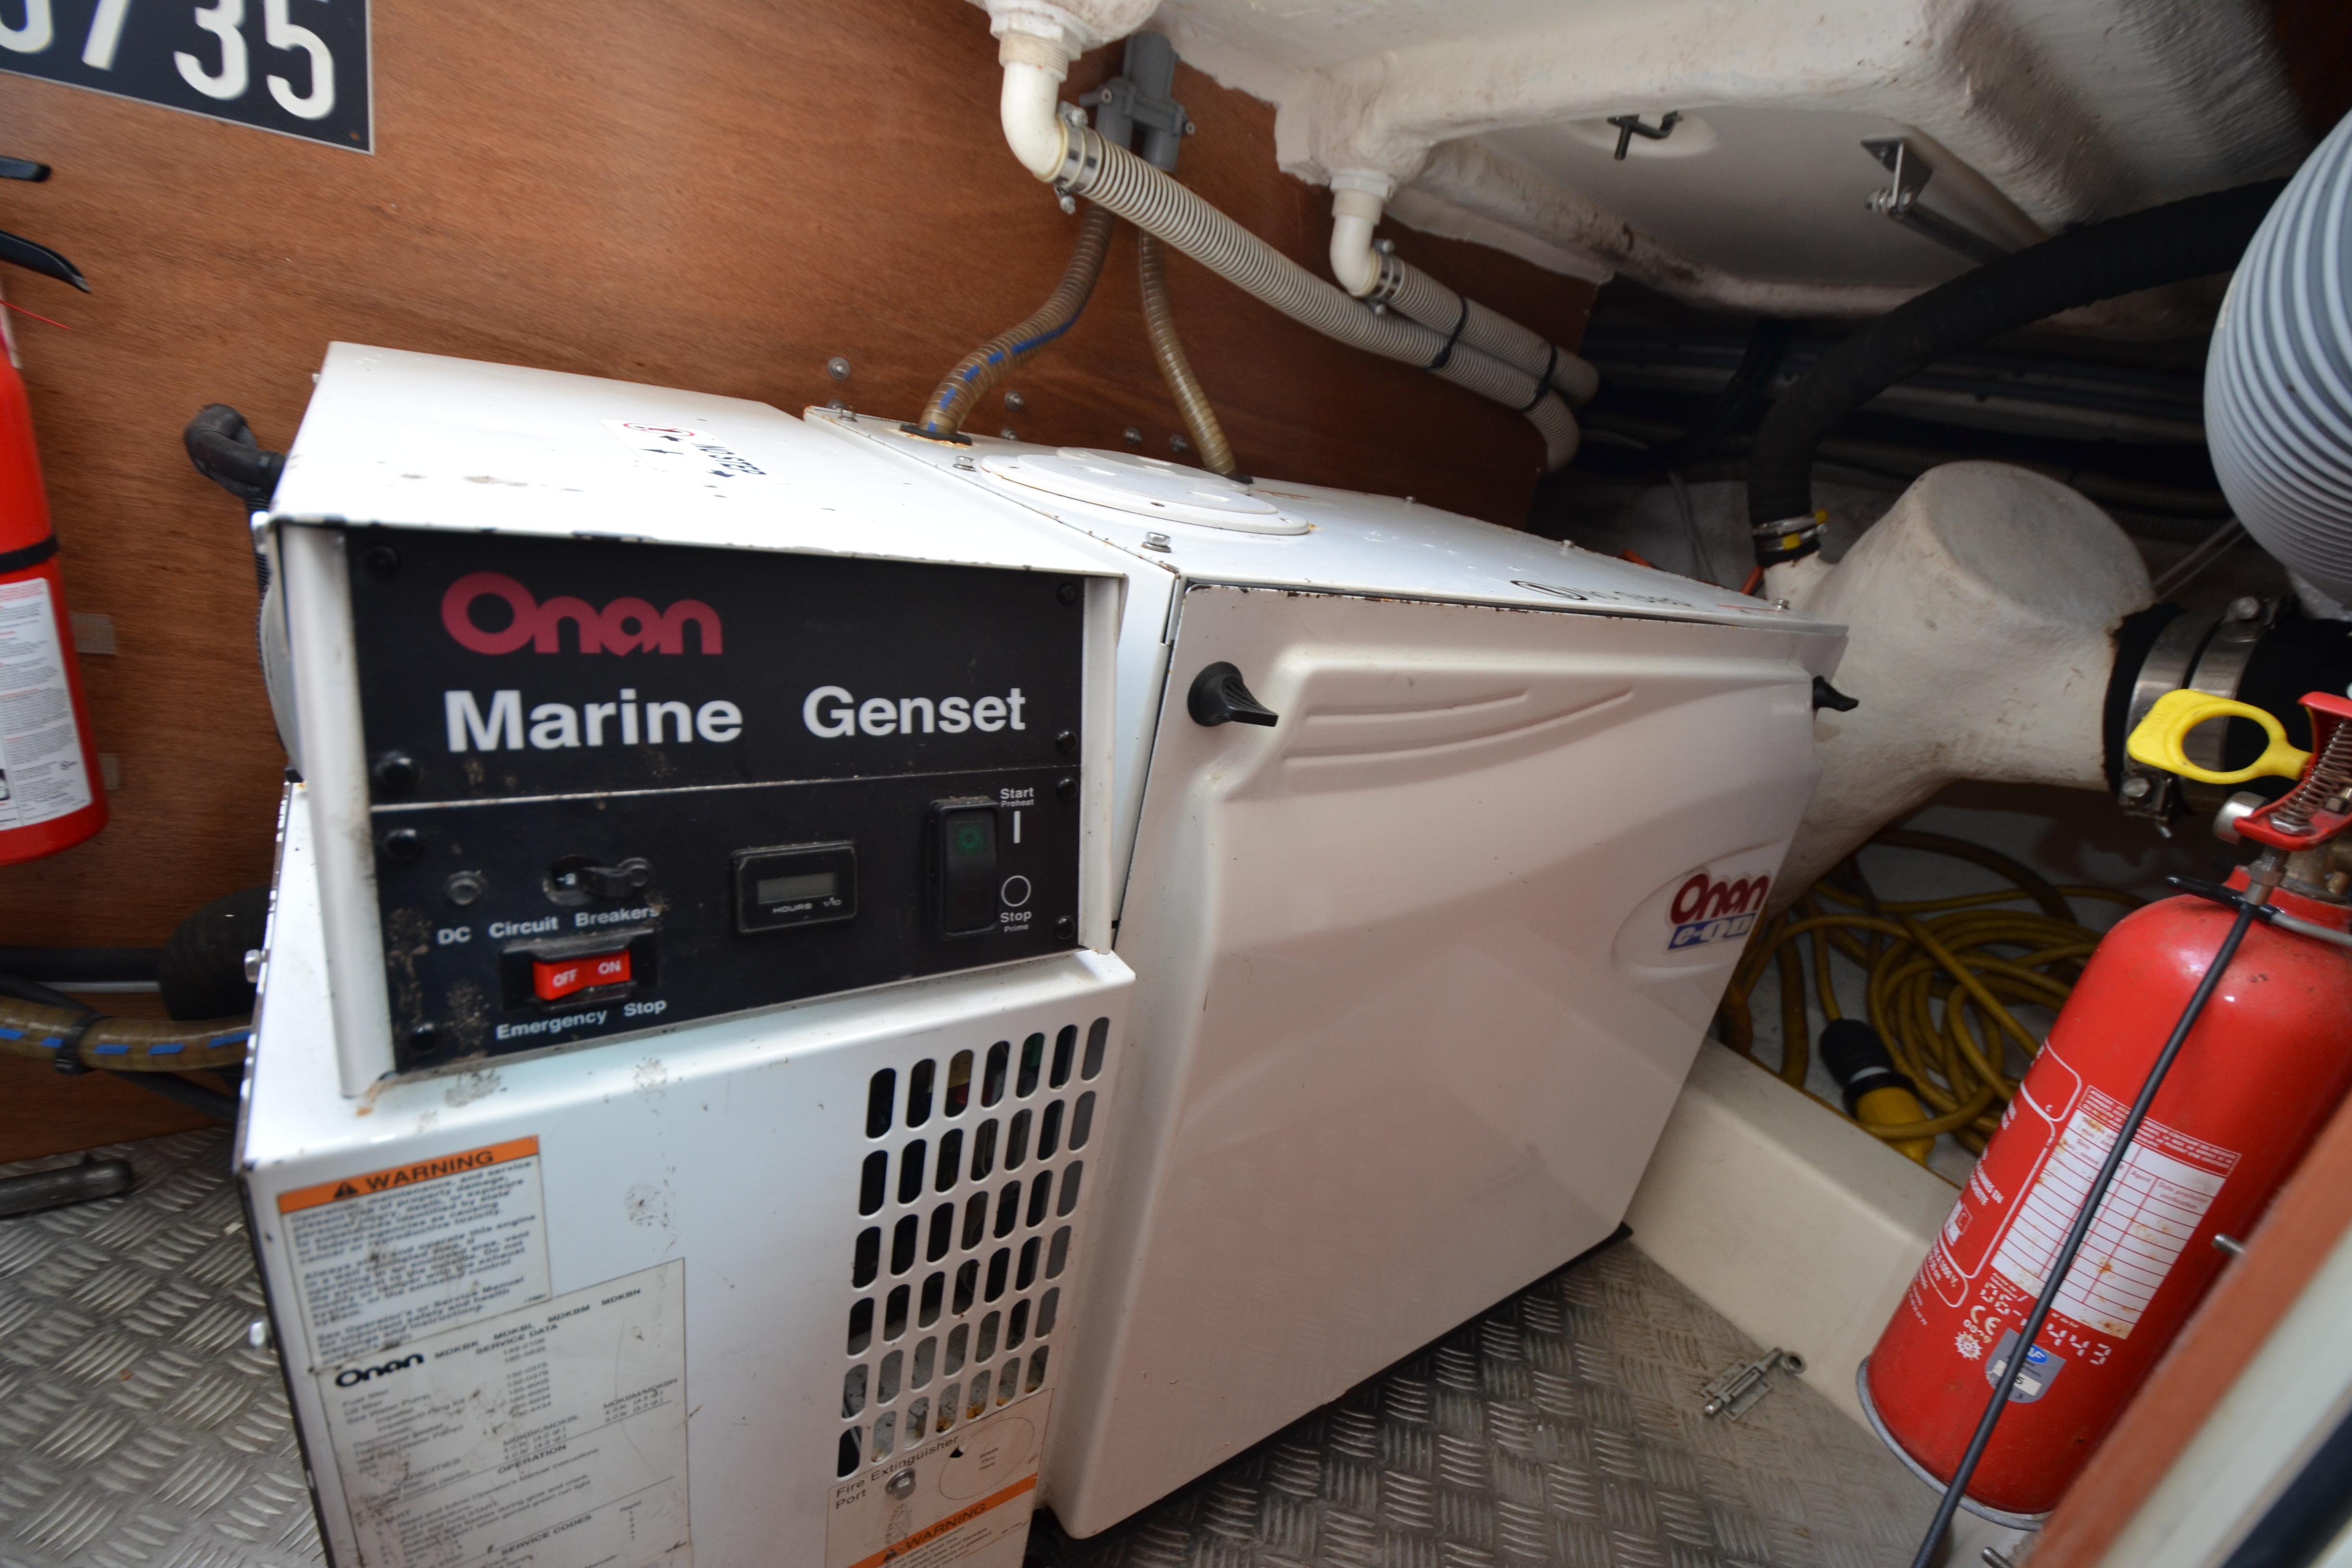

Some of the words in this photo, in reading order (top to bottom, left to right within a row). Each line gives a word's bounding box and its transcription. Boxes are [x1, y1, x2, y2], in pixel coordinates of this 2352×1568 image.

[441, 572, 722, 657] Onan
[444, 687, 743, 753] Marine
[802, 685, 1026, 739] Genset
[1000, 787, 1034, 799] Start
[1001, 798, 1034, 807] Preheat
[772, 903, 812, 914] HOURS
[1000, 911, 1032, 925] Stop
[1670, 874, 1769, 924] Onan
[438, 926, 471, 945] DC
[489, 916, 559, 939] Circuit
[575, 905, 660, 927] Breakers
[1004, 923, 1029, 933] Prime
[552, 968, 577, 988] OFF
[599, 960, 622, 976] ON
[496, 1009, 607, 1041] Emergency
[624, 999, 667, 1018] Stop
[366, 1151, 495, 1191] WARNING
[475, 1333, 526, 1355] SERVICE
[528, 1322, 559, 1338] DATA
[333, 1347, 425, 1391] Onan
[497, 1442, 566, 1475] OPERATION
[836, 1480, 865, 1498] Fire
[870, 1435, 960, 1481] Extinguisher
[835, 1490, 866, 1509] Port
[501, 1530, 550, 1556] SERVICE
[552, 1512, 591, 1534] CODES
[906, 1503, 986, 1548] WARNING
